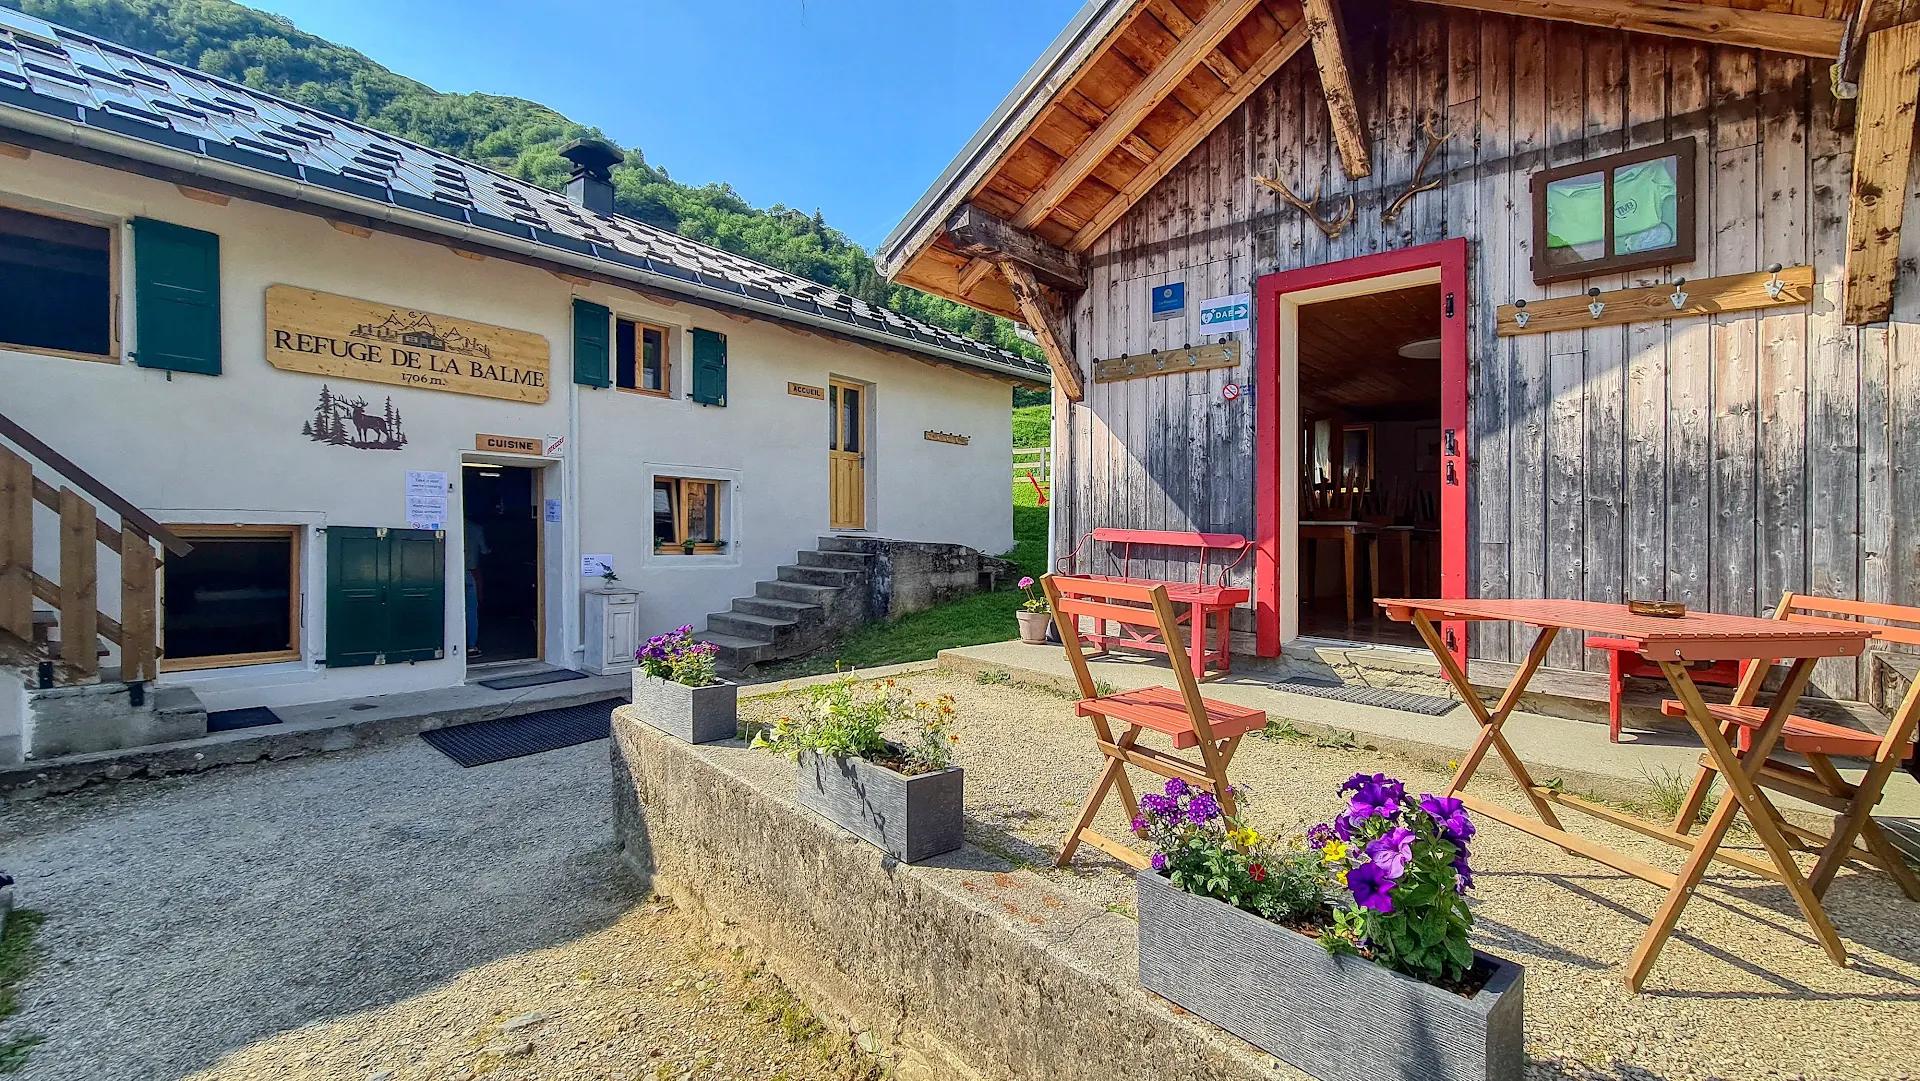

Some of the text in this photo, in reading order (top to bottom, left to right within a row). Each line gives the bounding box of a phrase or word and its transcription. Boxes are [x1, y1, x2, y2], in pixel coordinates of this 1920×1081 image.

[1215, 309, 1234, 318] DAE
[274, 329, 545, 388] REFUGE DE LA BALME
[401, 373, 446, 386] 1706 m.
[793, 385, 820, 396] ACCUEIL
[487, 438, 534, 450] CUISINE
